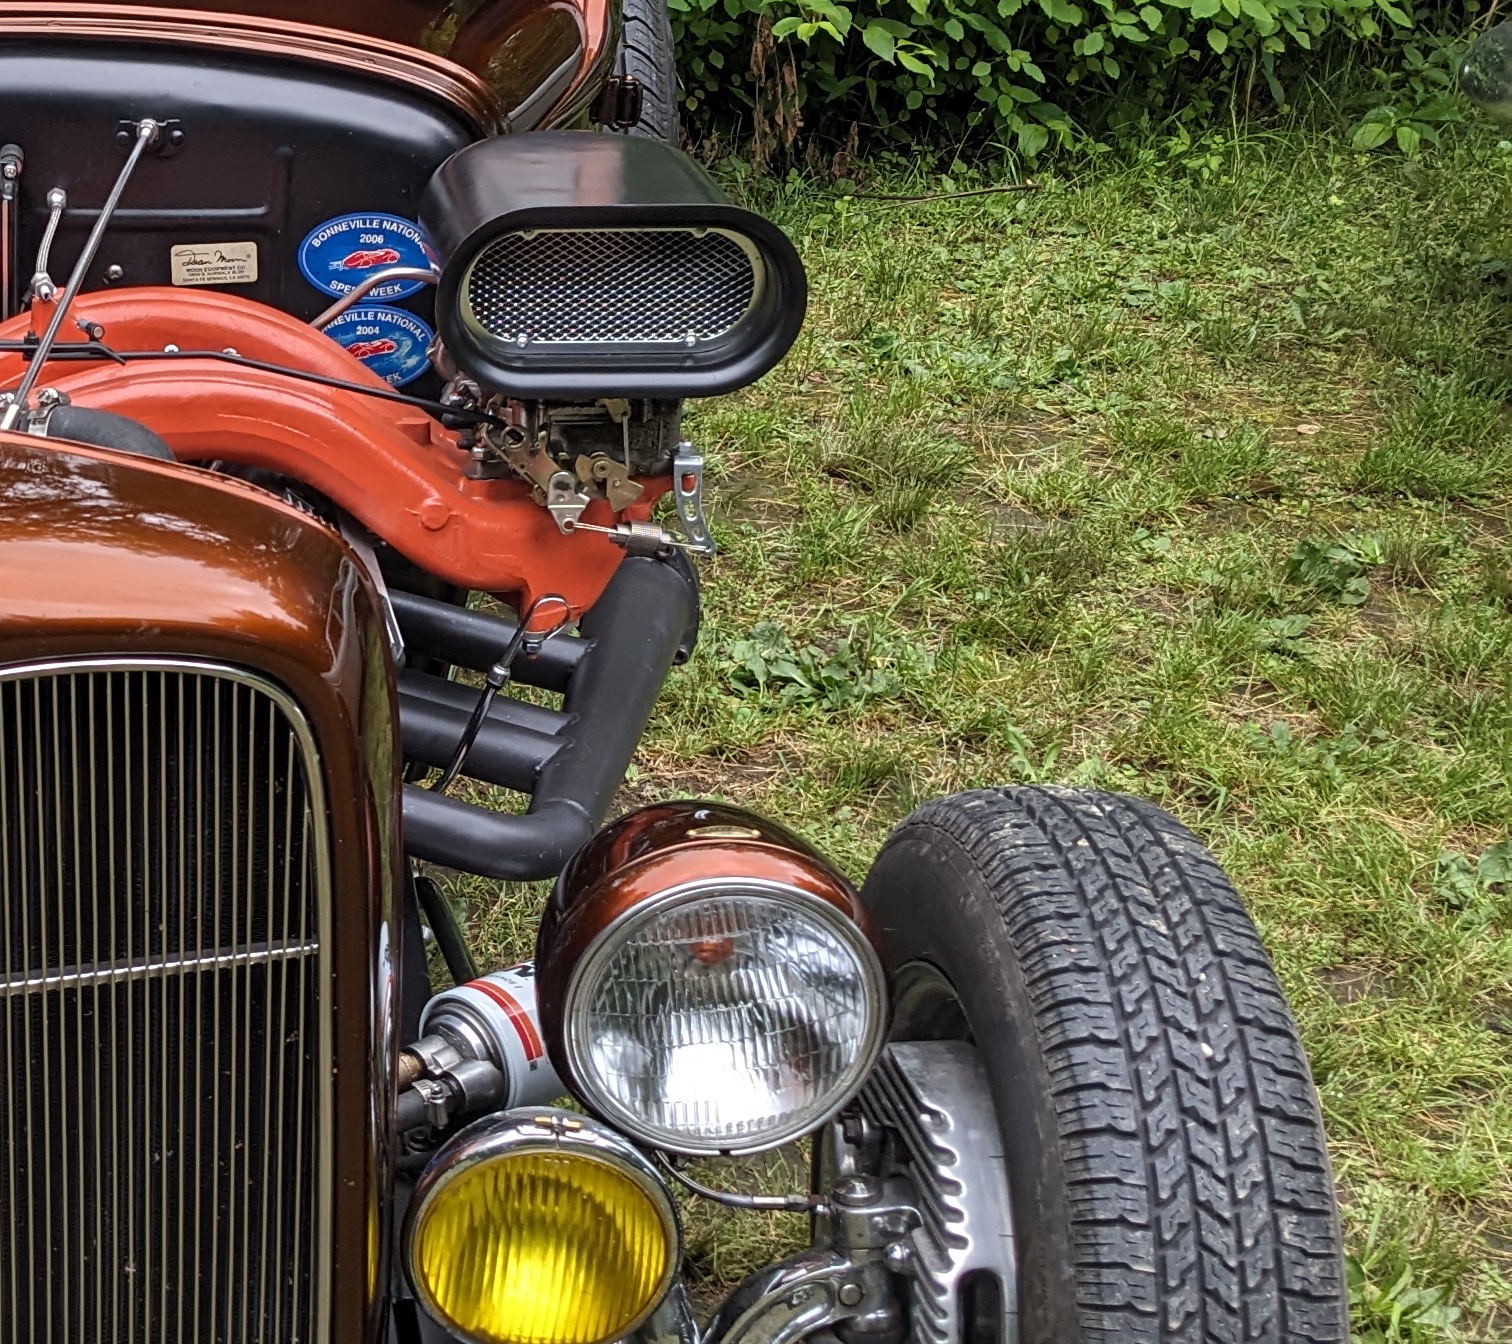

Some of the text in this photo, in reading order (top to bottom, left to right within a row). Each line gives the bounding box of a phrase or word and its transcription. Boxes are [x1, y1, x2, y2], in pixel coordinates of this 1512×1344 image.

[311, 219, 380, 248] BONNEVILLE
[329, 279, 402, 297] SPE WEEK
[377, 312, 426, 342] NATIONAL
